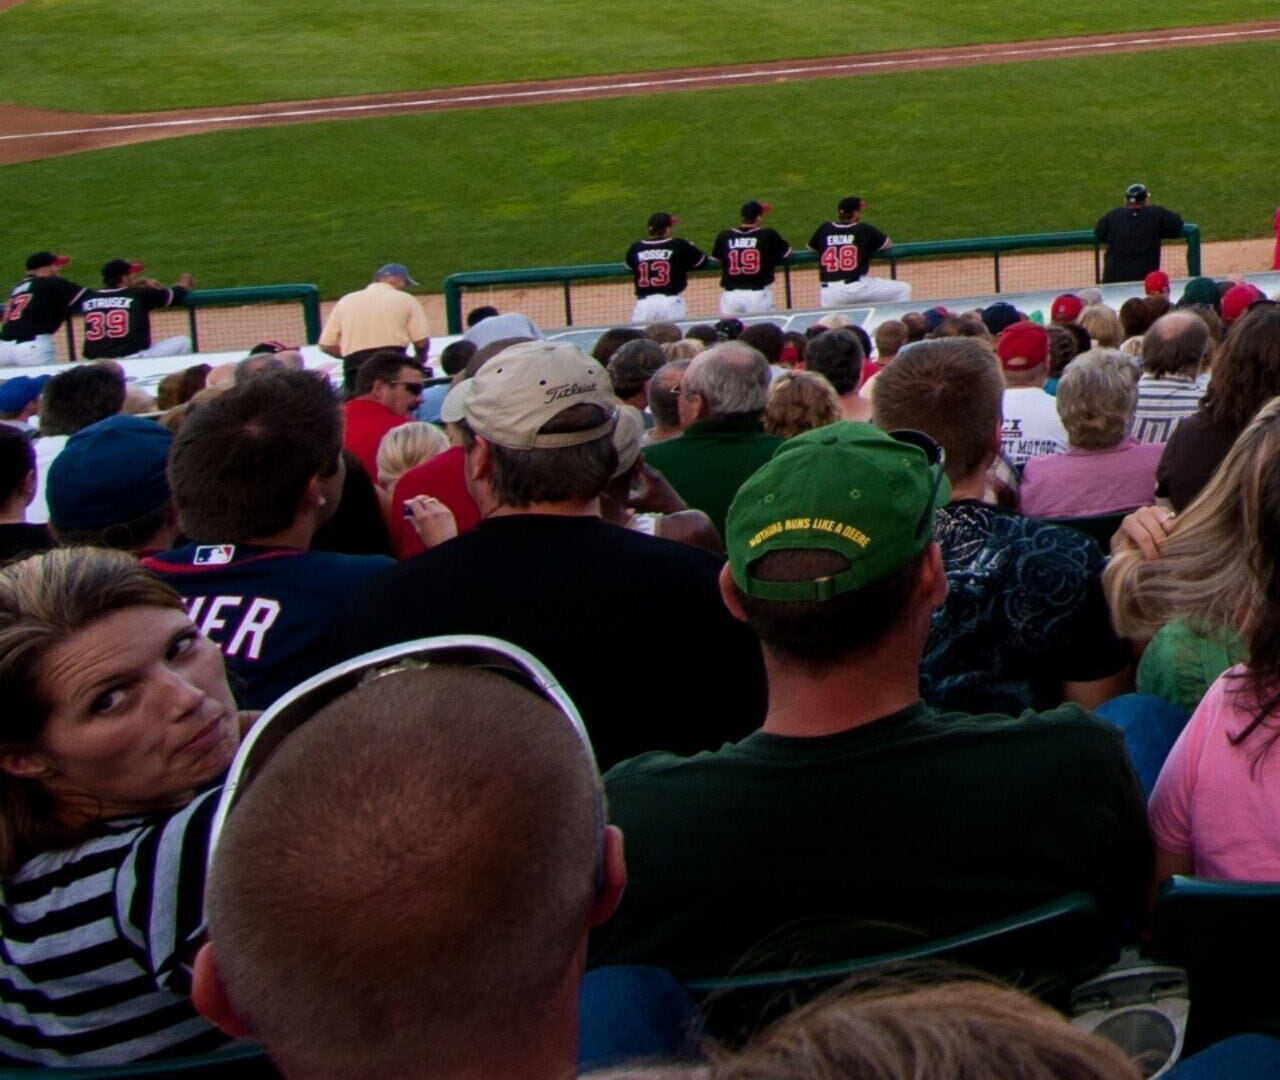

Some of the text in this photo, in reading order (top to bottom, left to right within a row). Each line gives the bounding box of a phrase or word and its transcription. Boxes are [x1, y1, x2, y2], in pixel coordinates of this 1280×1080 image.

[728, 248, 760, 276] 19
[821, 245, 858, 271] 48
[637, 260, 671, 287] 13
[85, 309, 129, 341] 39
[748, 518, 871, 550] NOTHING RUNS LIKE A DEERE
